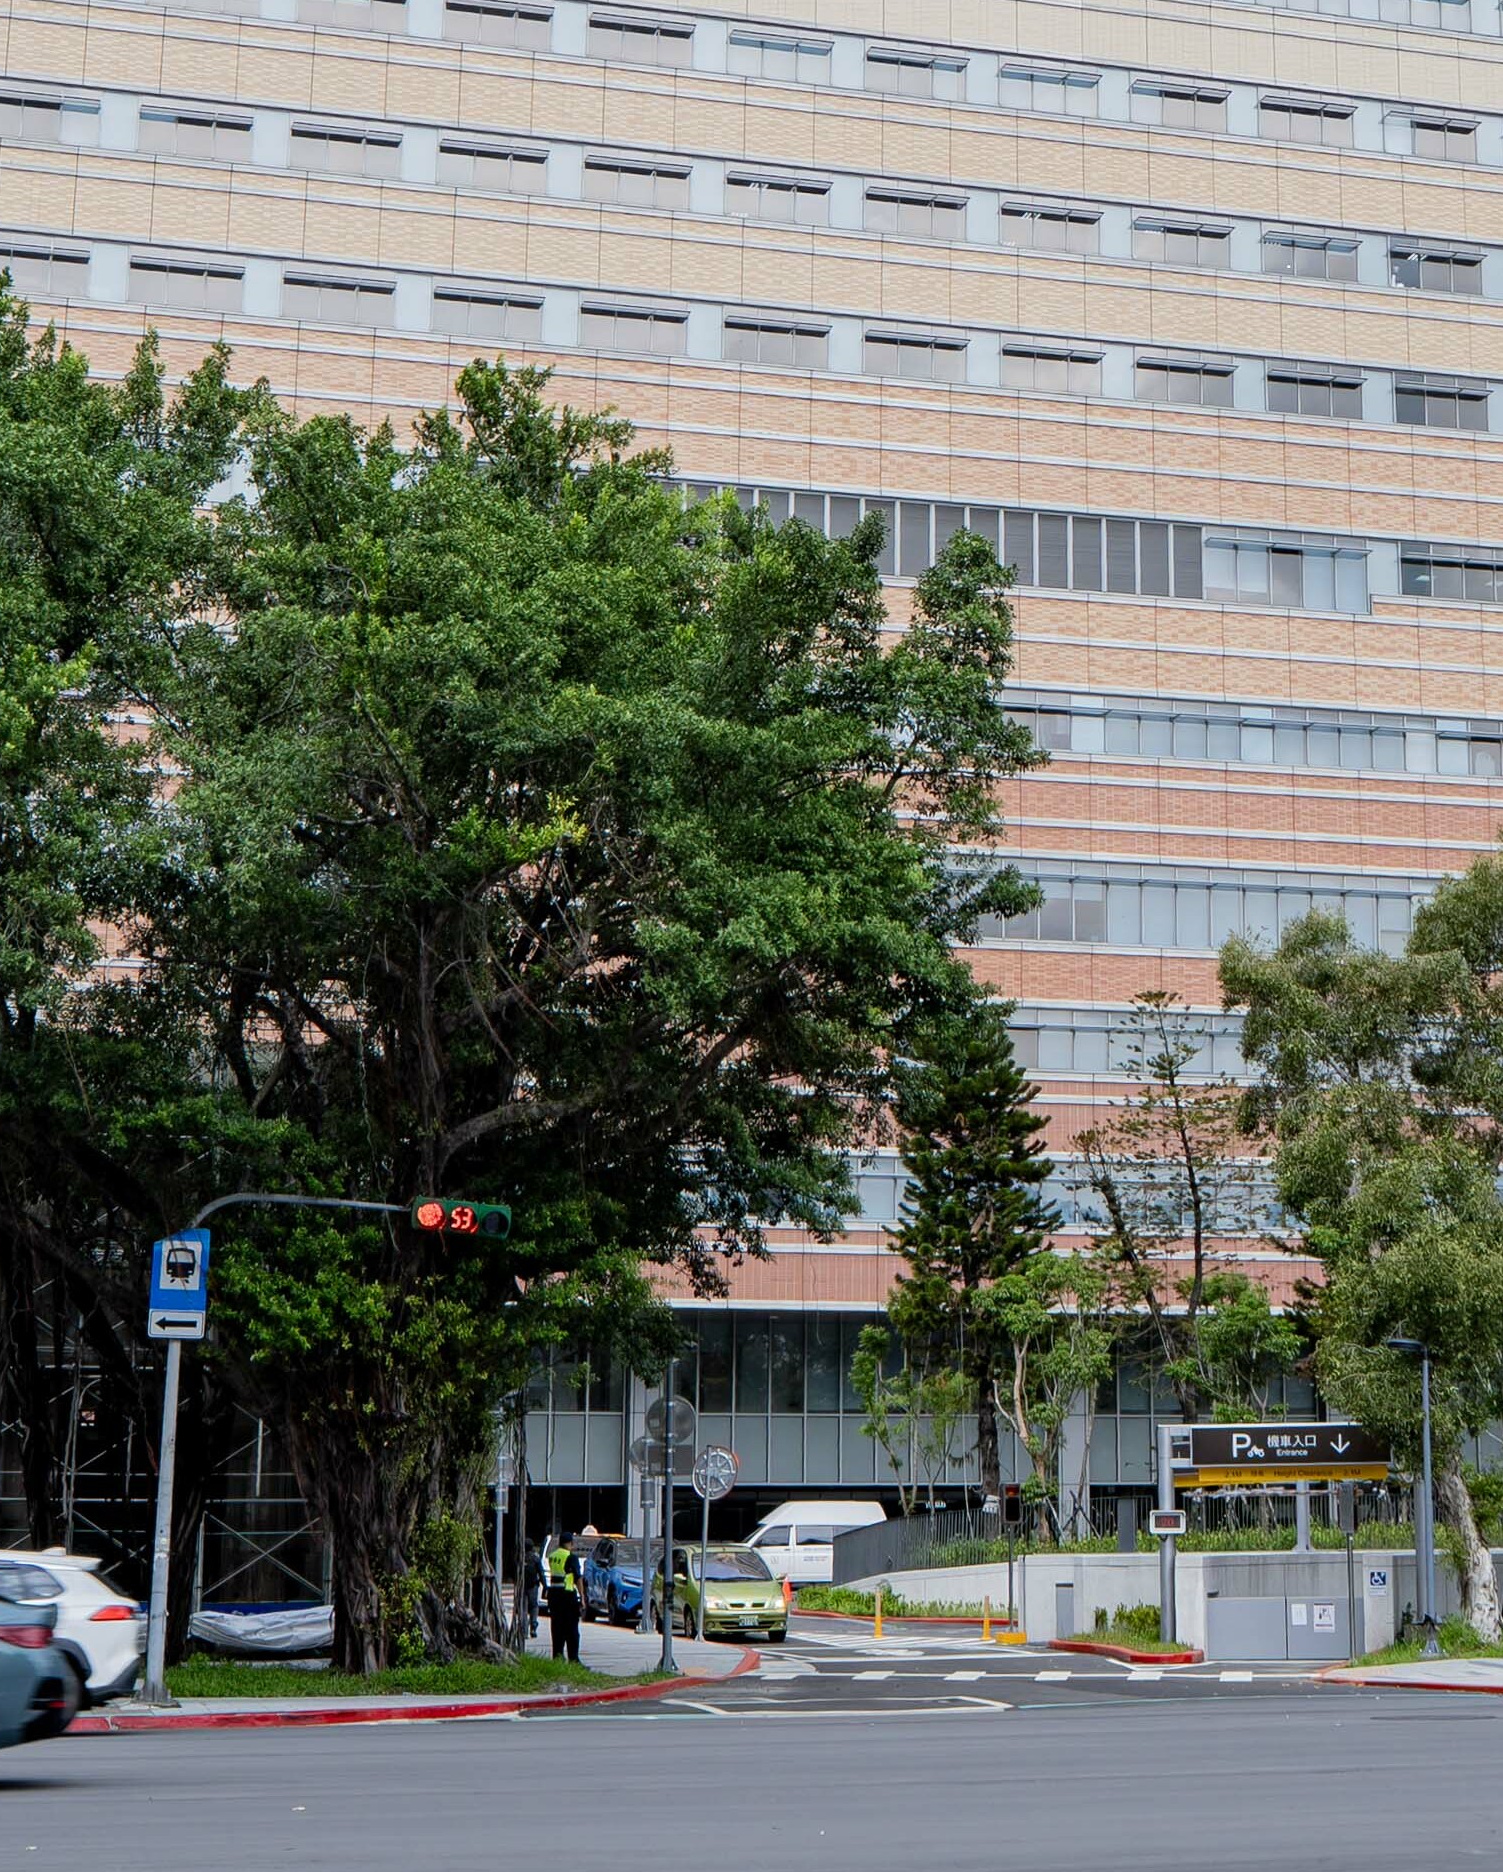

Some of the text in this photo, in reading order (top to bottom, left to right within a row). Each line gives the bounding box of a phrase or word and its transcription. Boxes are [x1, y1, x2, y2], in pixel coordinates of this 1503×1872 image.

[451, 1207, 473, 1229] 53
[1232, 1433, 1251, 1458] P
[1267, 1435, 1317, 1448] 機車入口
[1276, 1449, 1308, 1457] Entrance
[1274, 1469, 1296, 1478] Height
[1298, 1469, 1333, 1477] Clearance
